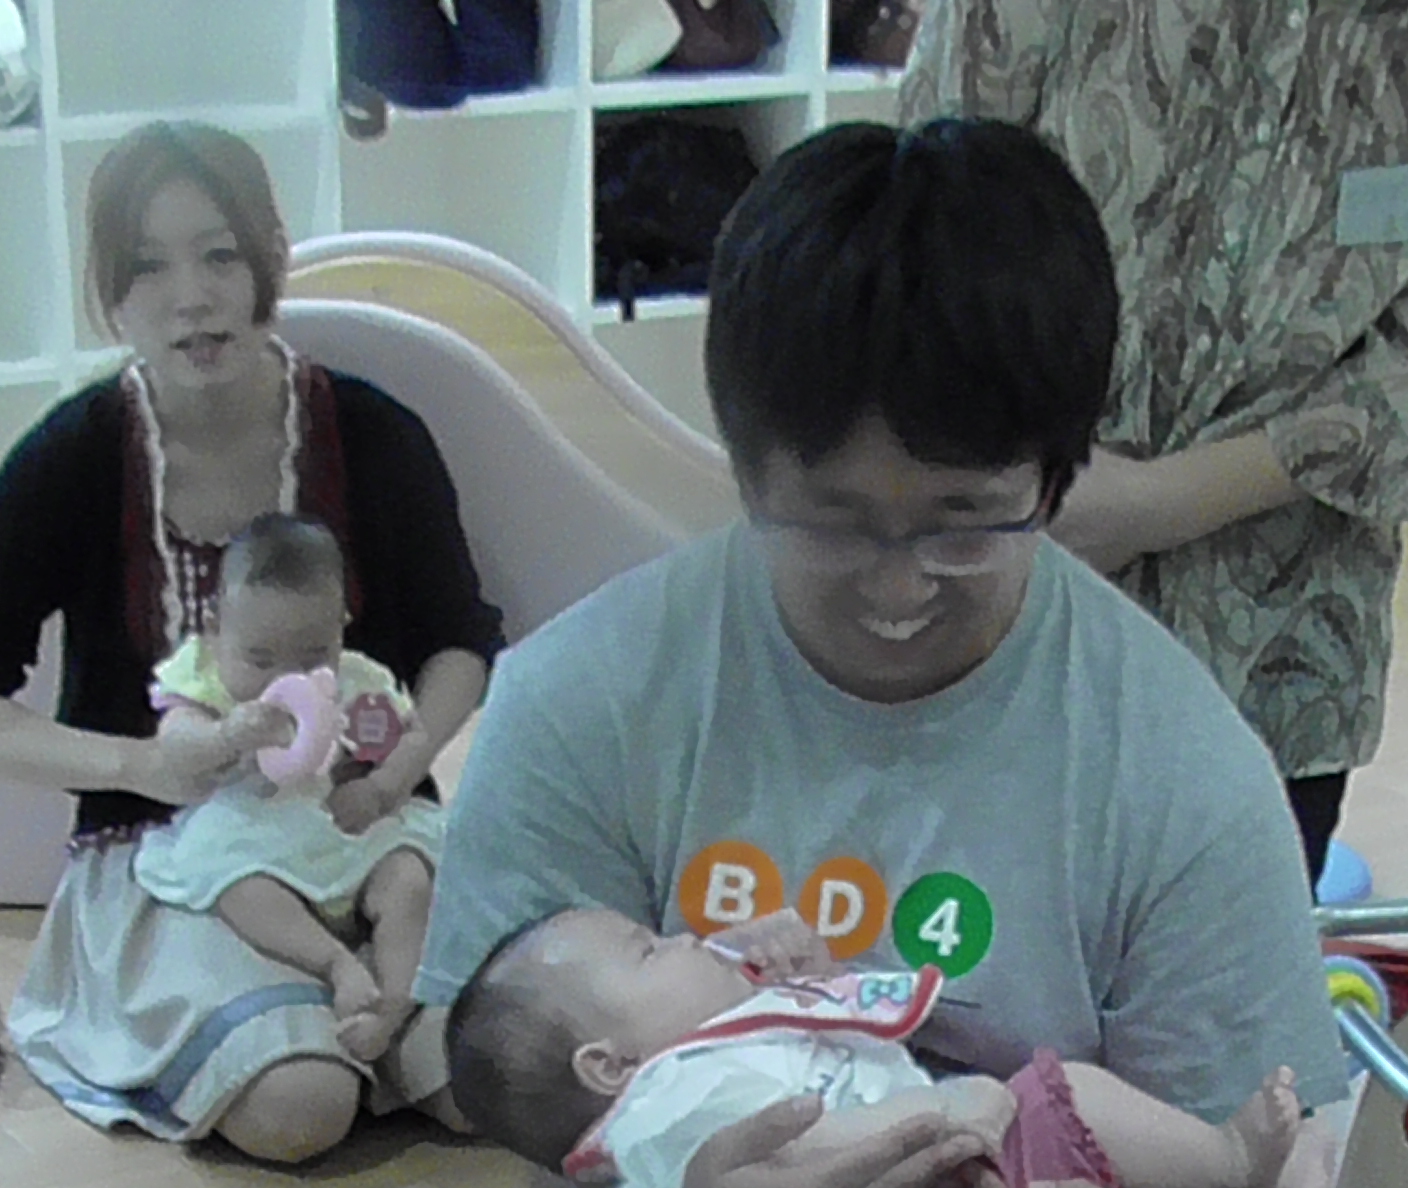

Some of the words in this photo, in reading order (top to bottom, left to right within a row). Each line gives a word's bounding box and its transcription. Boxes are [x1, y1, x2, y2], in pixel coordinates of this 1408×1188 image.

[703, 862, 756, 922] B
[817, 879, 864, 936] D
[918, 898, 961, 956] 4
